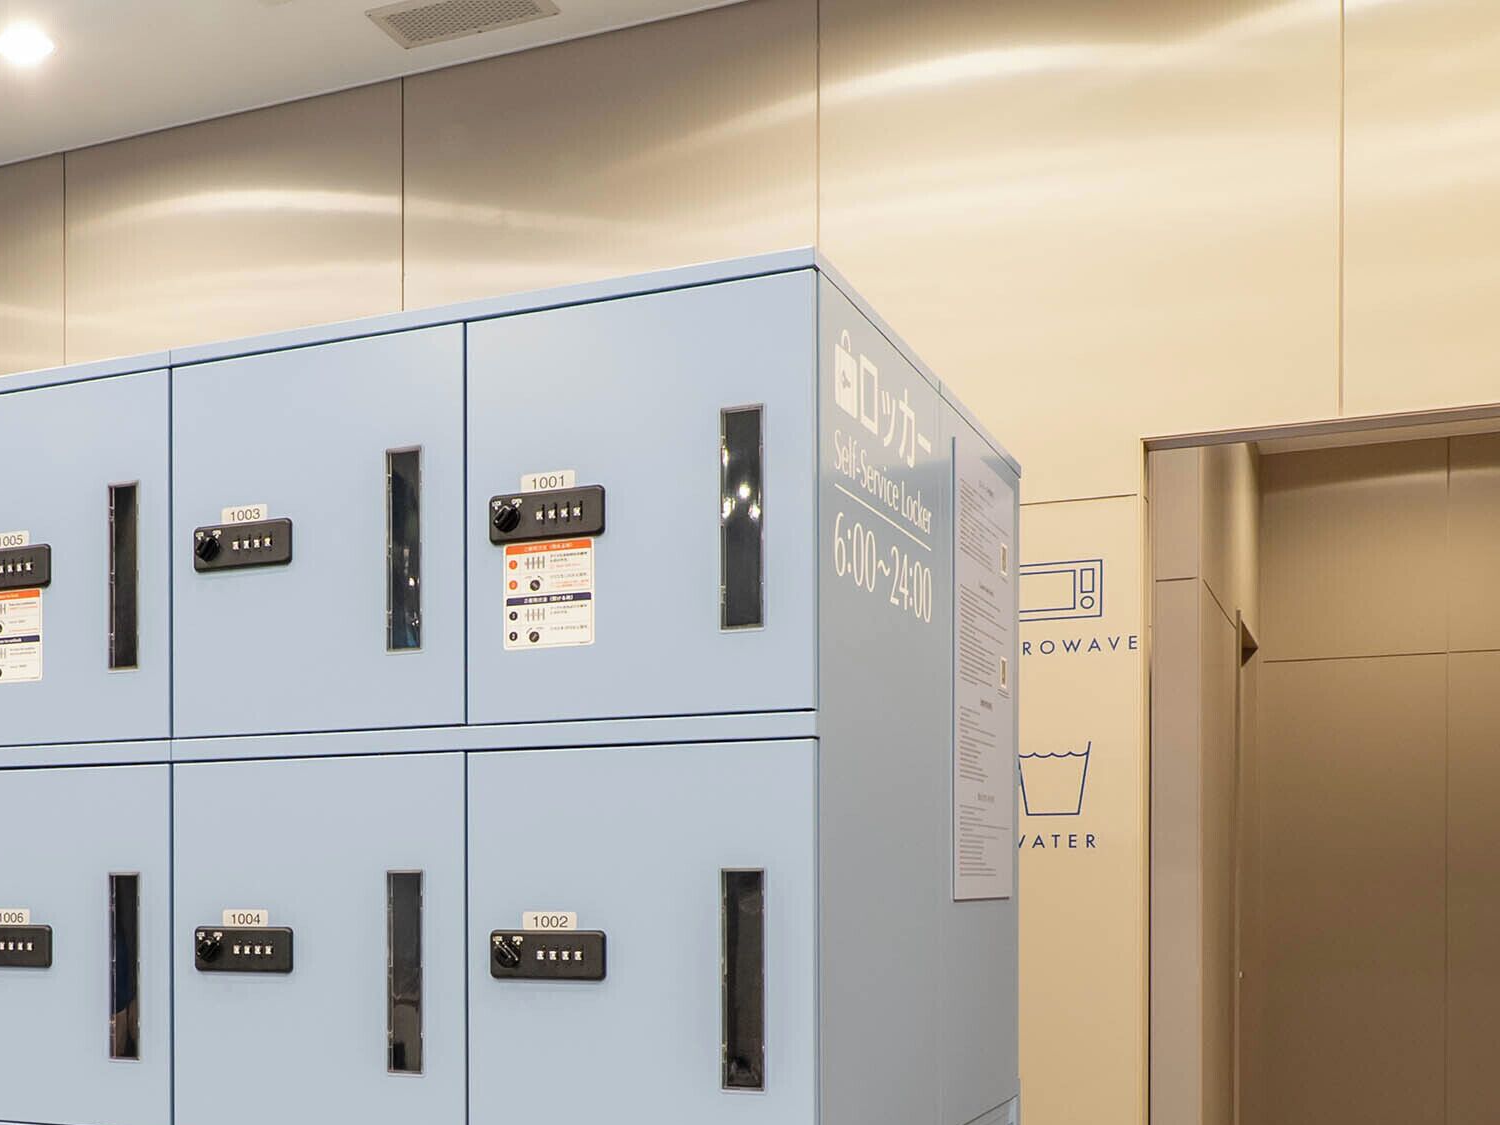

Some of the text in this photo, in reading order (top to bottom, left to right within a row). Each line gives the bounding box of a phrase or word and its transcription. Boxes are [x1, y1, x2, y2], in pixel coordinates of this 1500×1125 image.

[858, 353, 932, 470] ロッカー
[531, 475, 565, 491] 1001
[833, 430, 899, 508] Self-Service
[901, 481, 932, 536] Locker
[230, 508, 261, 521] 1003
[231, 913, 261, 925] 1004
[532, 915, 569, 928] 1002
